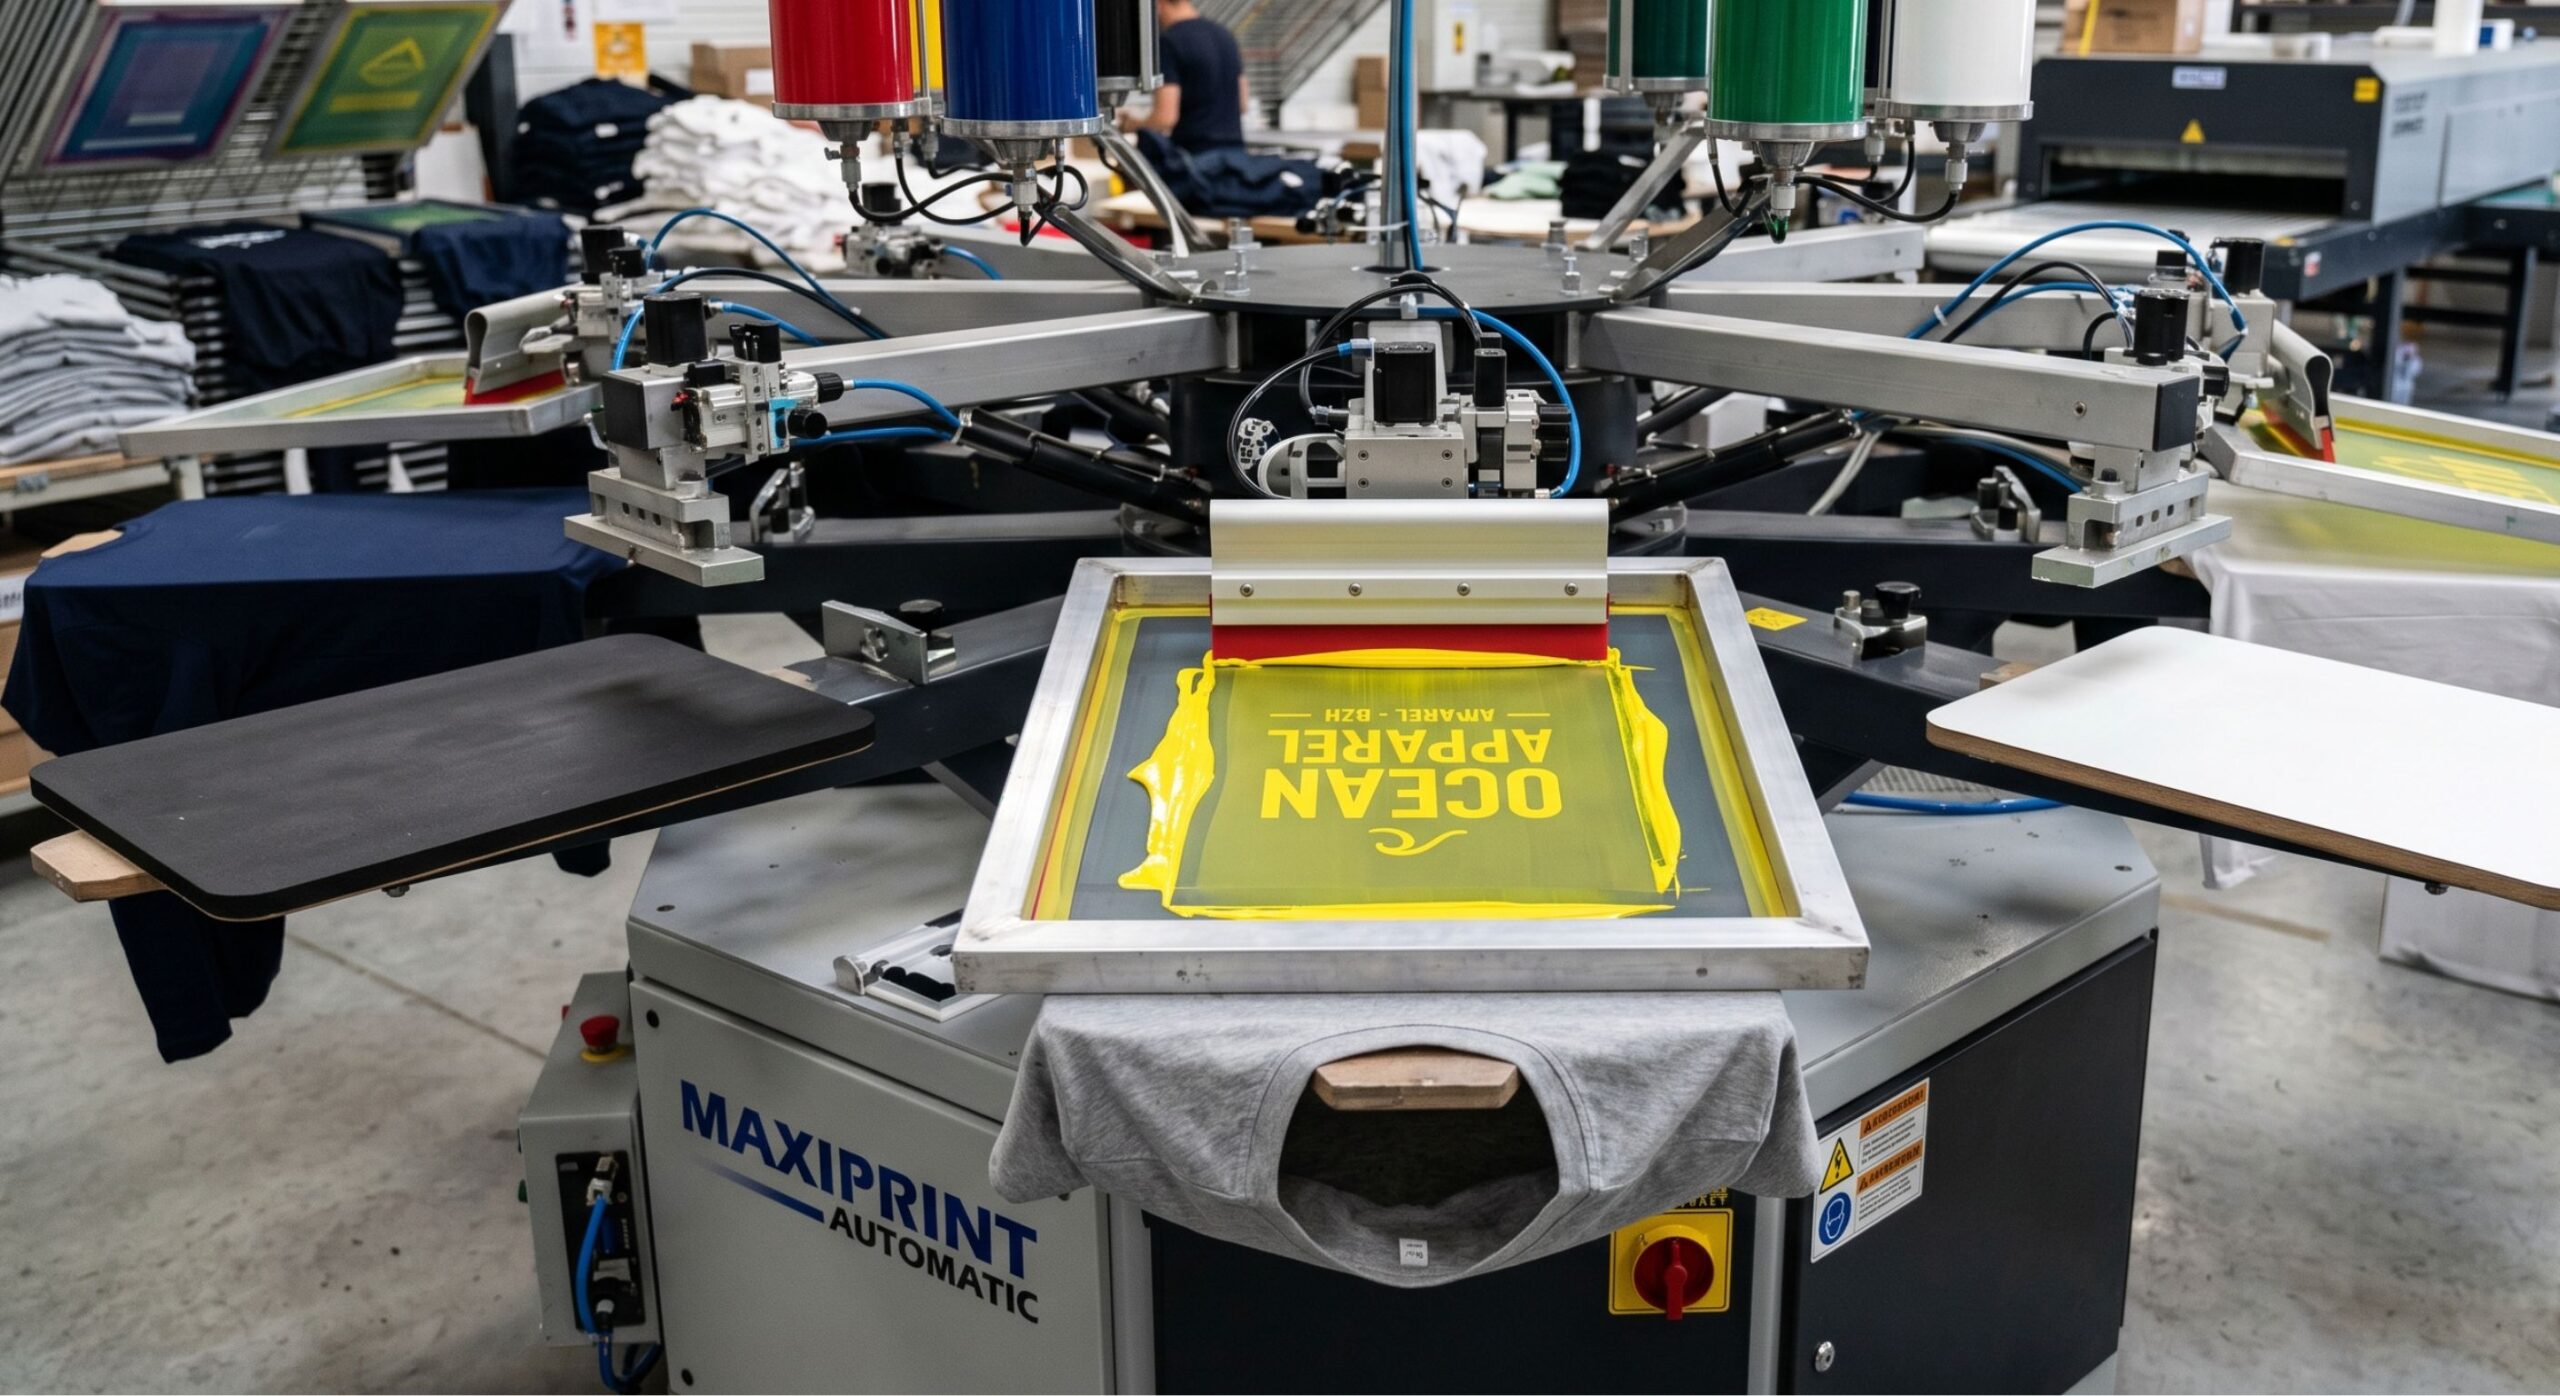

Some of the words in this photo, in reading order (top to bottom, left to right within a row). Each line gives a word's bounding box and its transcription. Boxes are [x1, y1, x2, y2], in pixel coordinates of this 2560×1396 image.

[1325, 708, 1371, 722] BZH
[1267, 728, 1552, 764] APPAREL
[1260, 768, 1562, 818] OCEAN
[680, 1079, 1037, 1279] MAXIPRINT
[829, 1206, 1039, 1324] AUTOMATIC
